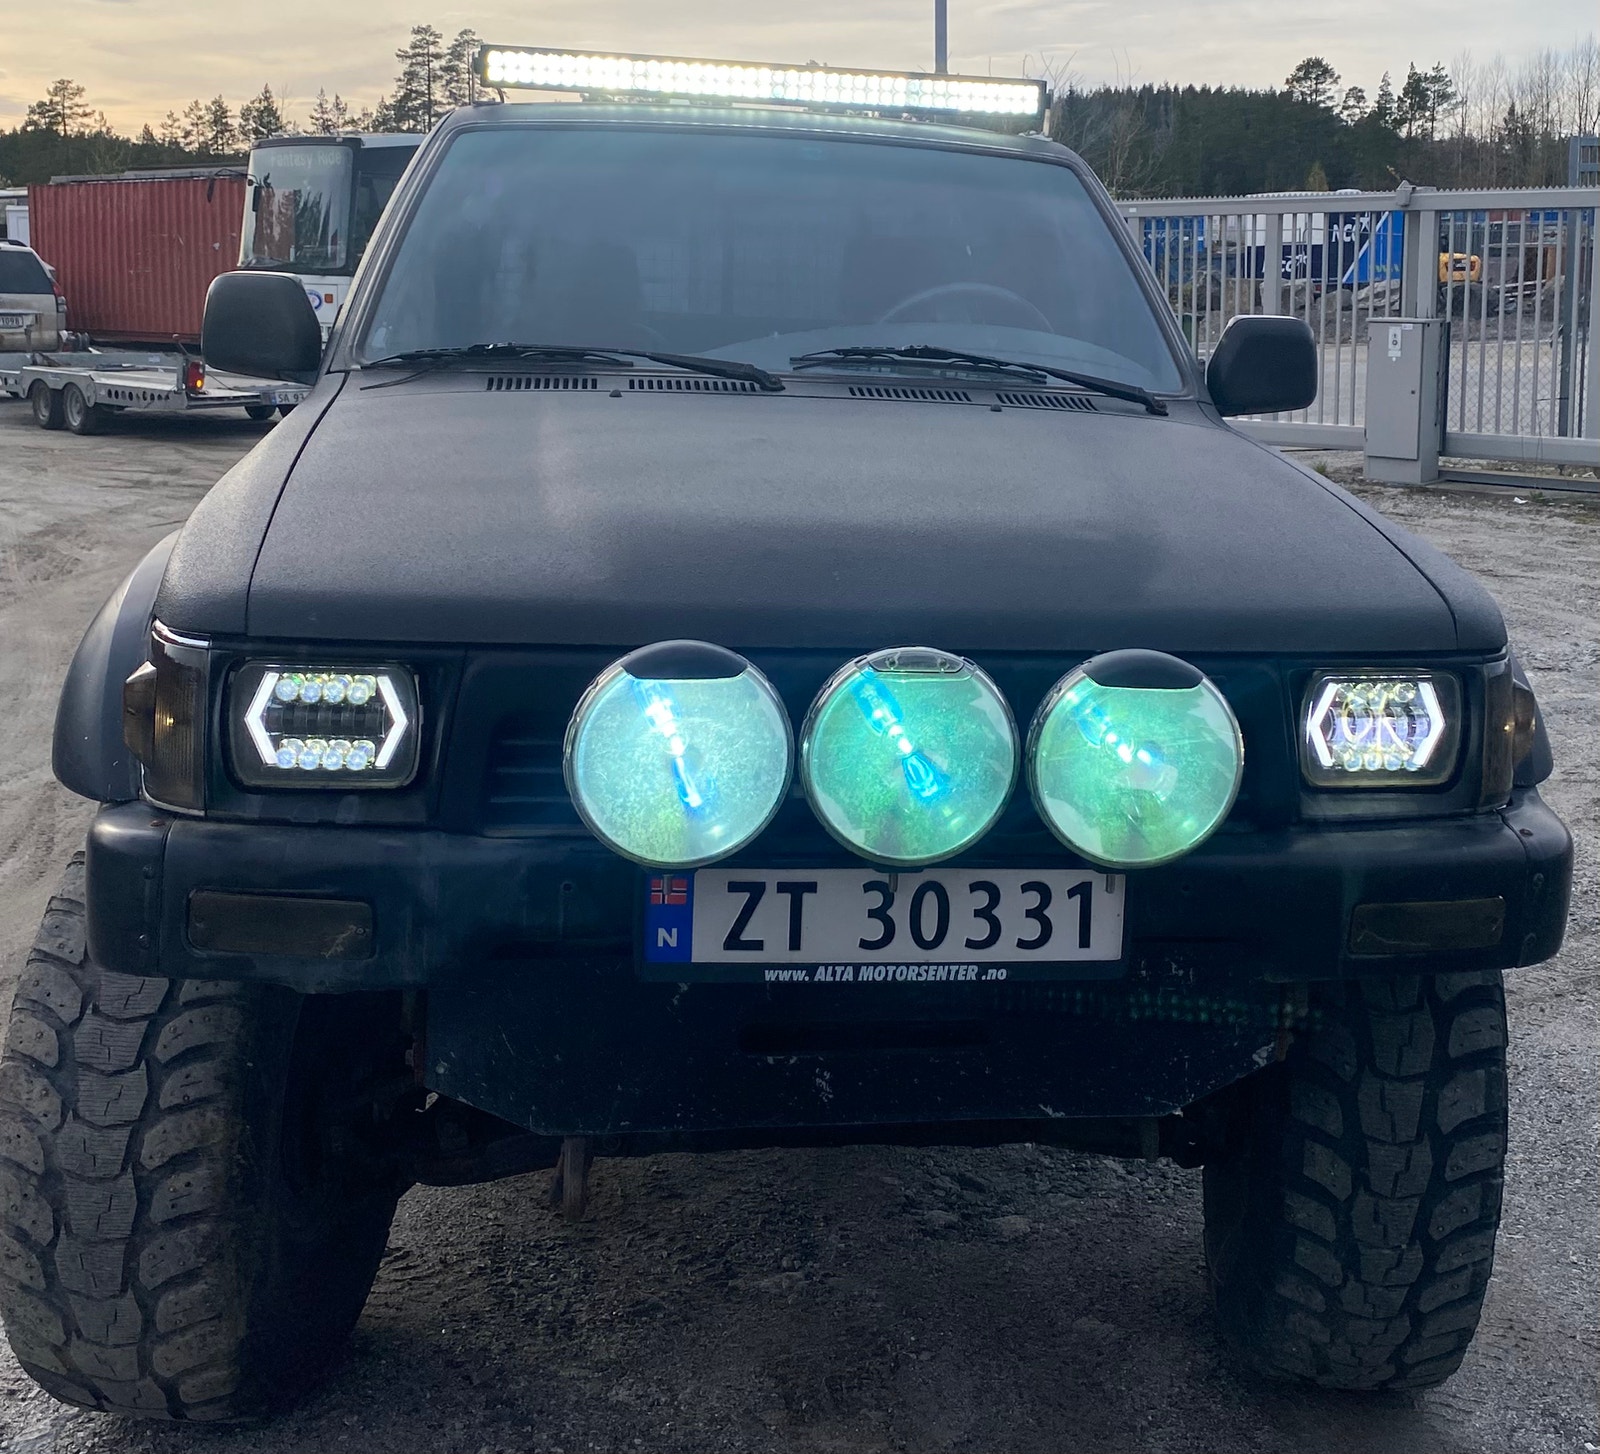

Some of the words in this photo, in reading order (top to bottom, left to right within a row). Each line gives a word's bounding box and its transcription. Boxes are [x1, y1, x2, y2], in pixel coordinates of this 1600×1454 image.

[278, 393, 290, 403] SA
[722, 880, 818, 951] ZT
[858, 880, 1094, 951] 30331
[657, 927, 678, 948] N
[764, 968, 809, 982] www.
[813, 965, 854, 982] ALTA
[857, 965, 978, 982] MOTORSENTER
[981, 967, 1008, 981] .no
